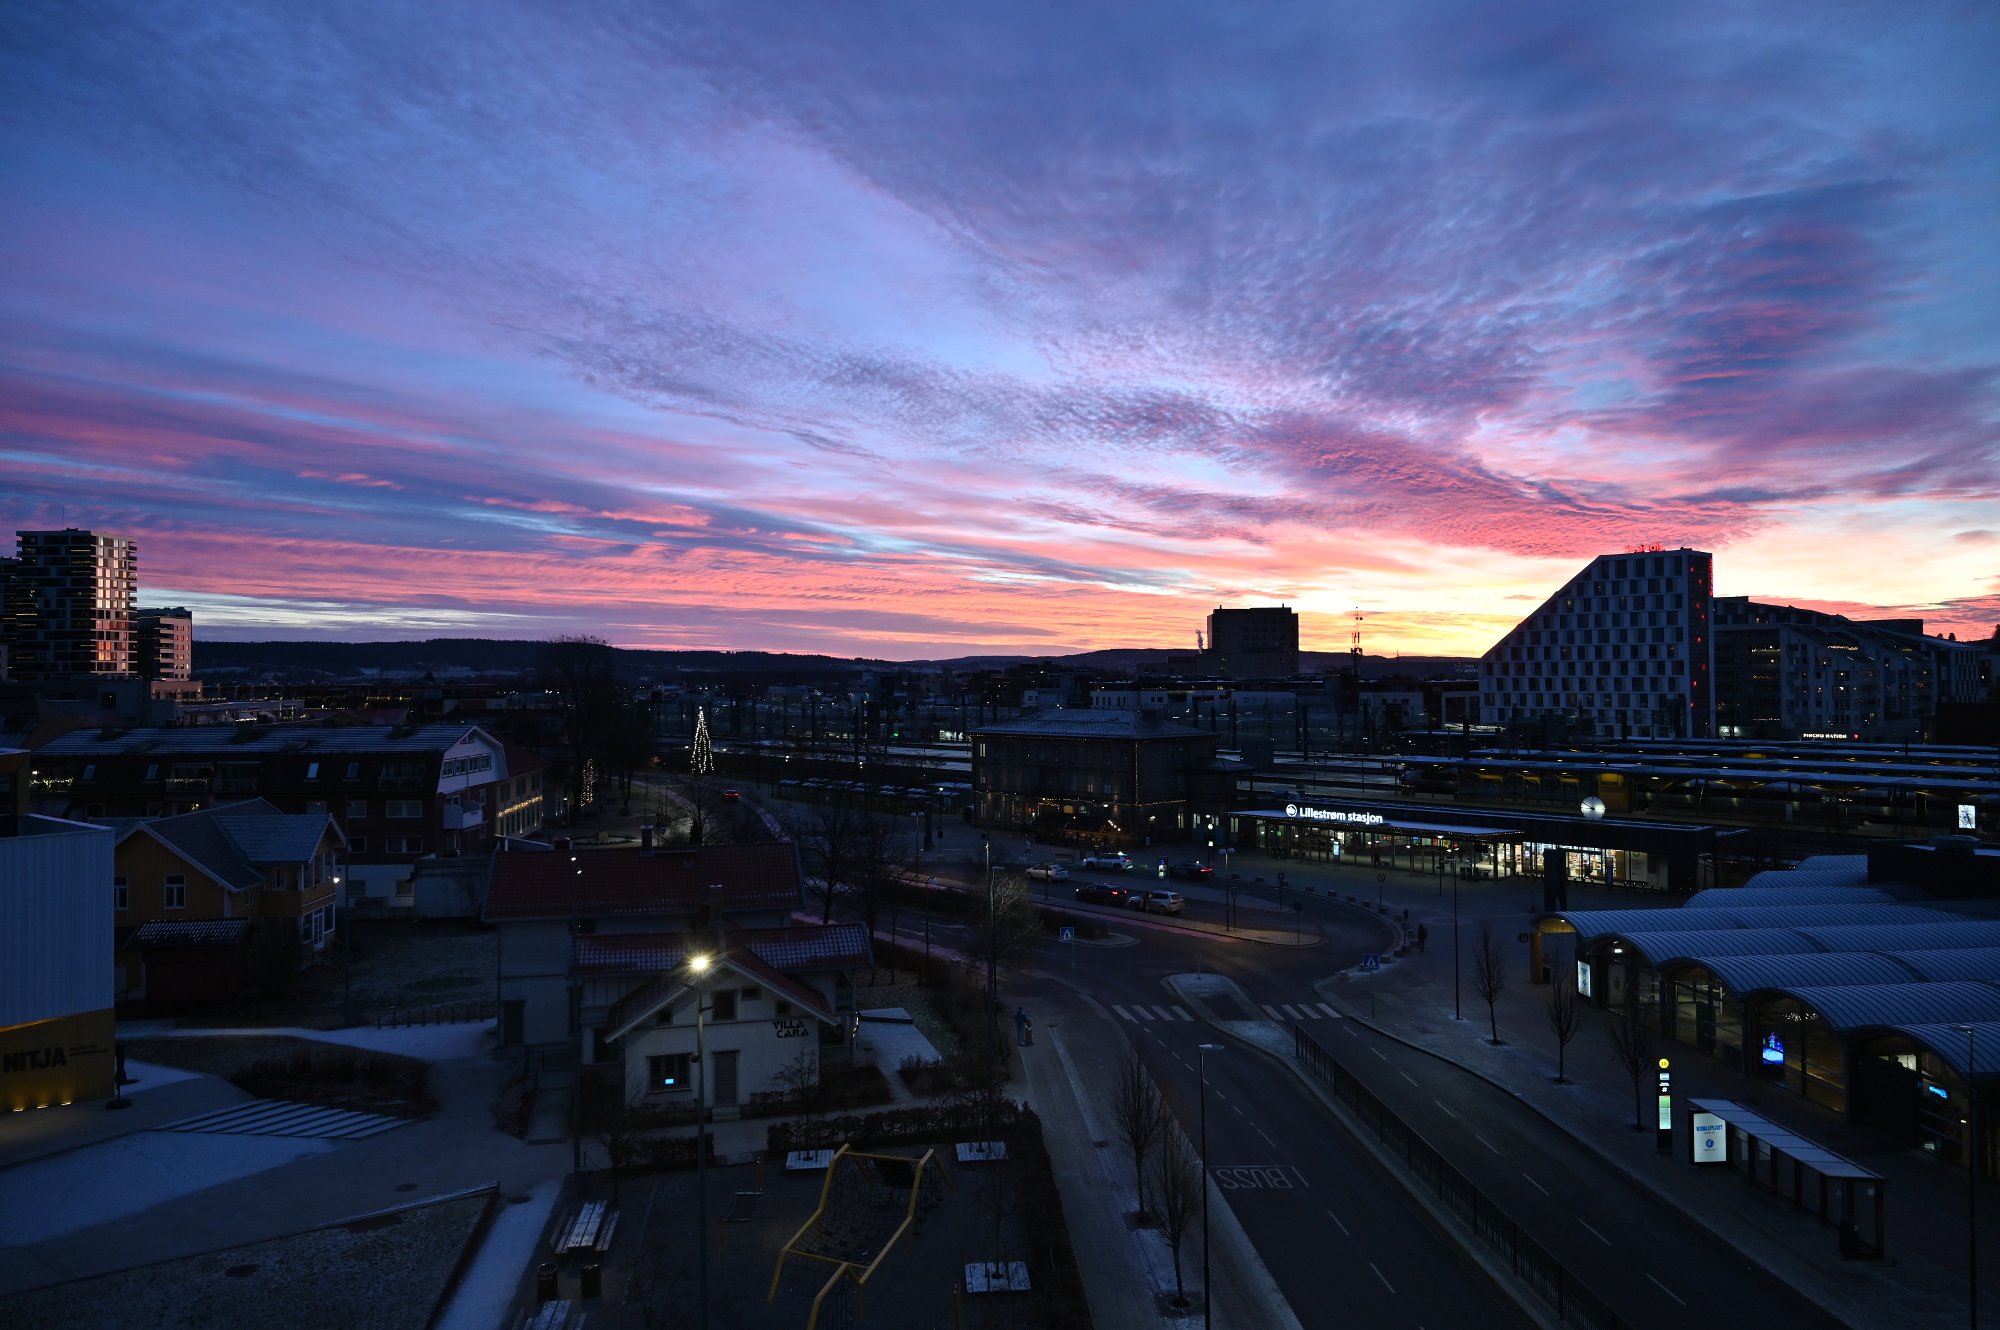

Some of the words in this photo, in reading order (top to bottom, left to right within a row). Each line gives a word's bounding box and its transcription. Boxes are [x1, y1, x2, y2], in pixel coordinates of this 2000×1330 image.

[1299, 807, 1346, 822] Lillestrøm
[1347, 811, 1383, 825] stasjon
[773, 1020, 805, 1029] VILLA
[776, 1028, 810, 1039] CARA
[3, 1046, 66, 1073] NITJA
[1216, 1168, 1294, 1189] BUSS
